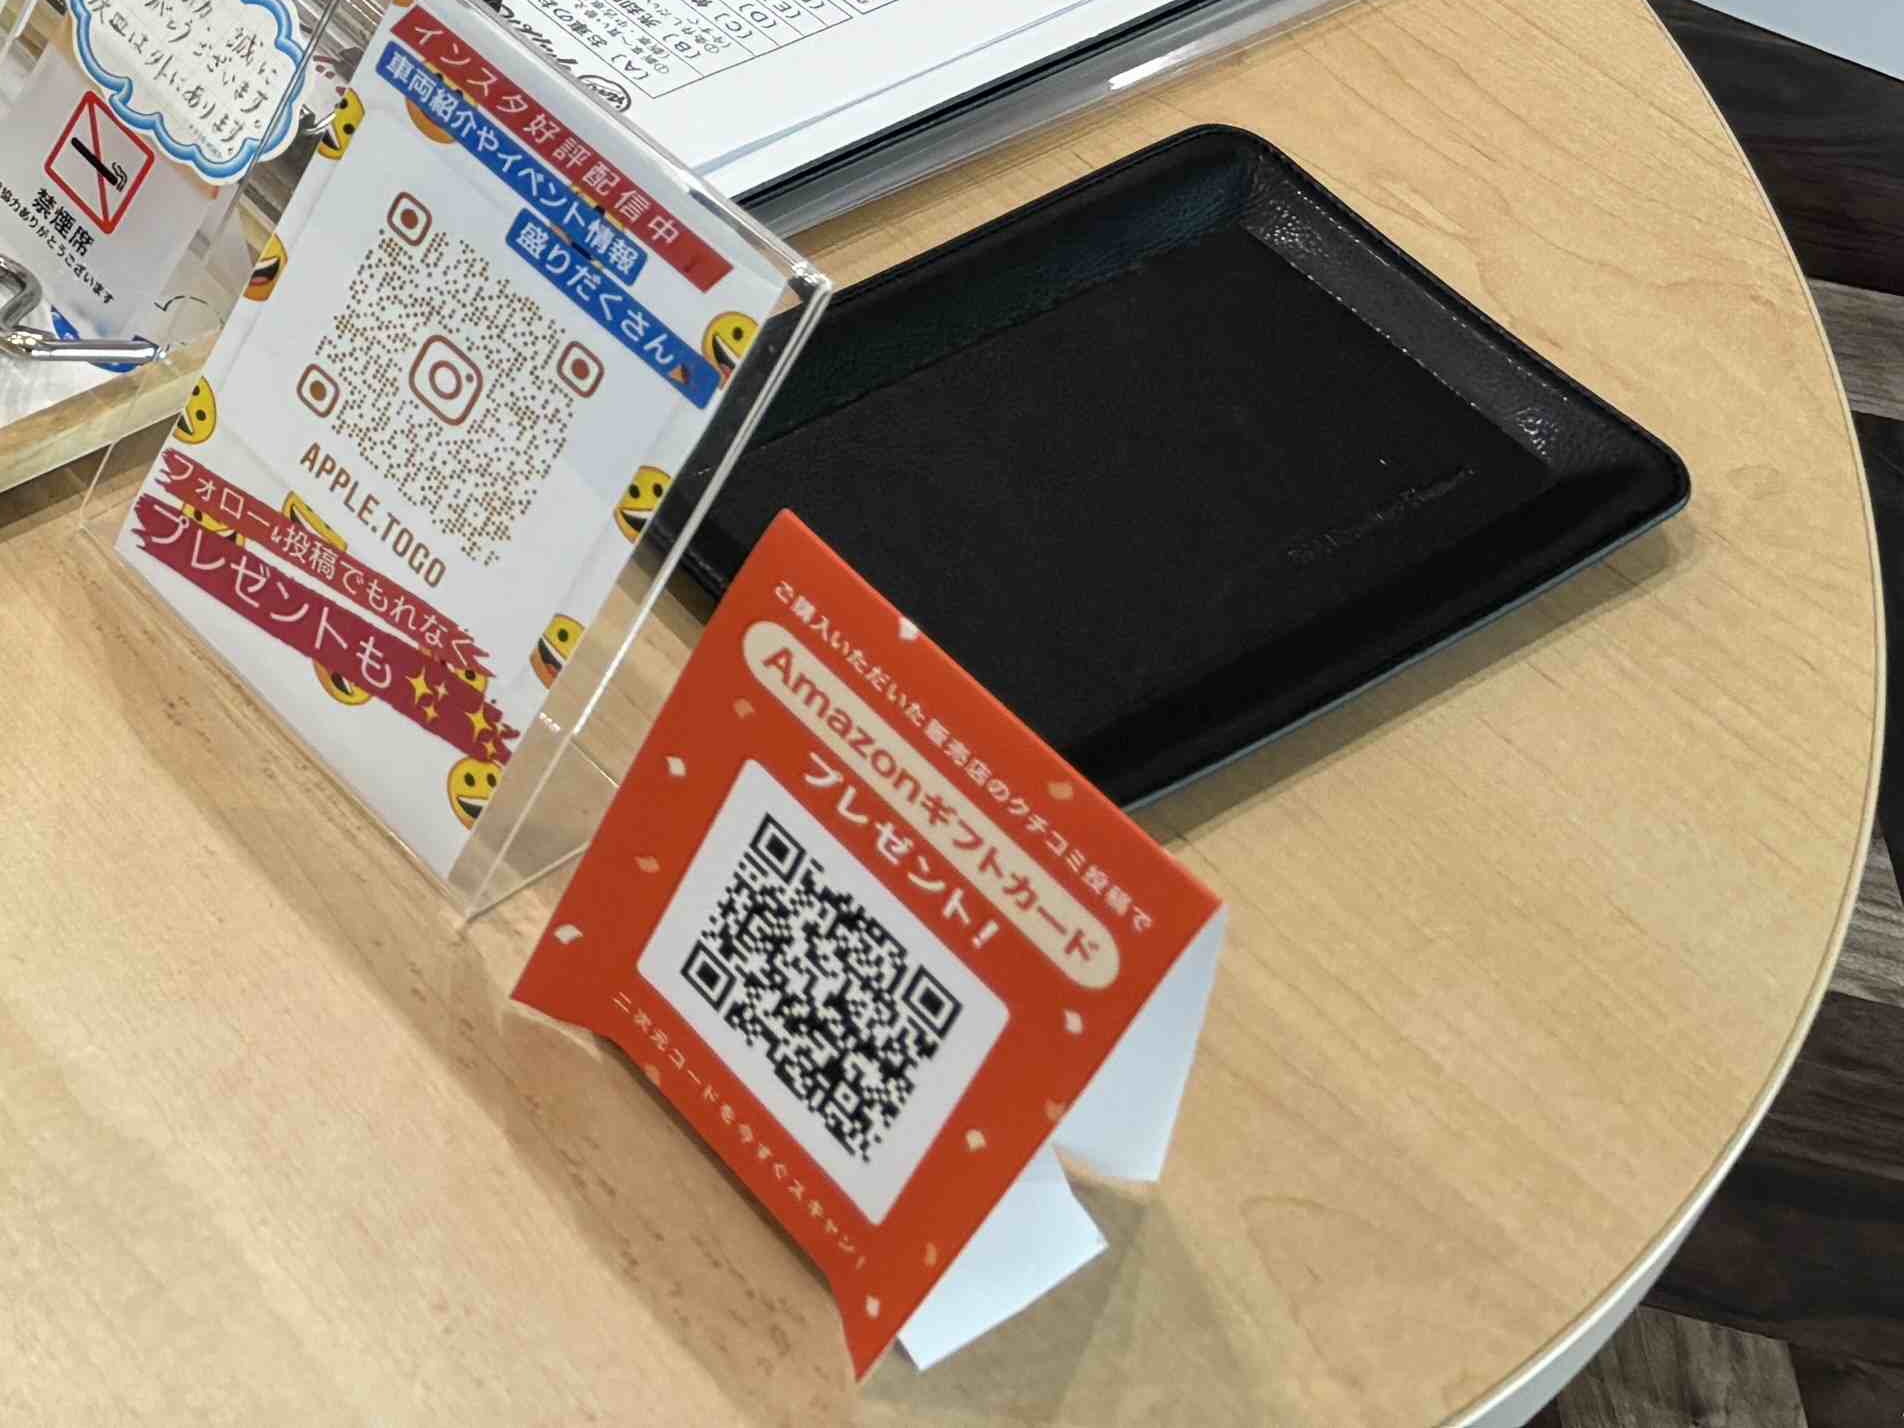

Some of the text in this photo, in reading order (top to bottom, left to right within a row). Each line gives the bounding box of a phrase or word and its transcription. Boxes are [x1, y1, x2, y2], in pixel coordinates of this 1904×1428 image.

[29, 185, 95, 252] 禁煙席
[381, 48, 641, 278] 車両紹介やイベント情報
[410, 14, 683, 252] インスタ好評配信中
[513, 218, 682, 374] 盛りだくさん
[141, 495, 403, 705] プレゼントも
[299, 439, 449, 592] APPLE.TOGO
[759, 636, 1105, 973] Amazonギフトカード
[771, 576, 1156, 939] ご購入いただいた販売店のクチコミ投稿で
[797, 748, 1001, 954] プレゼント！
